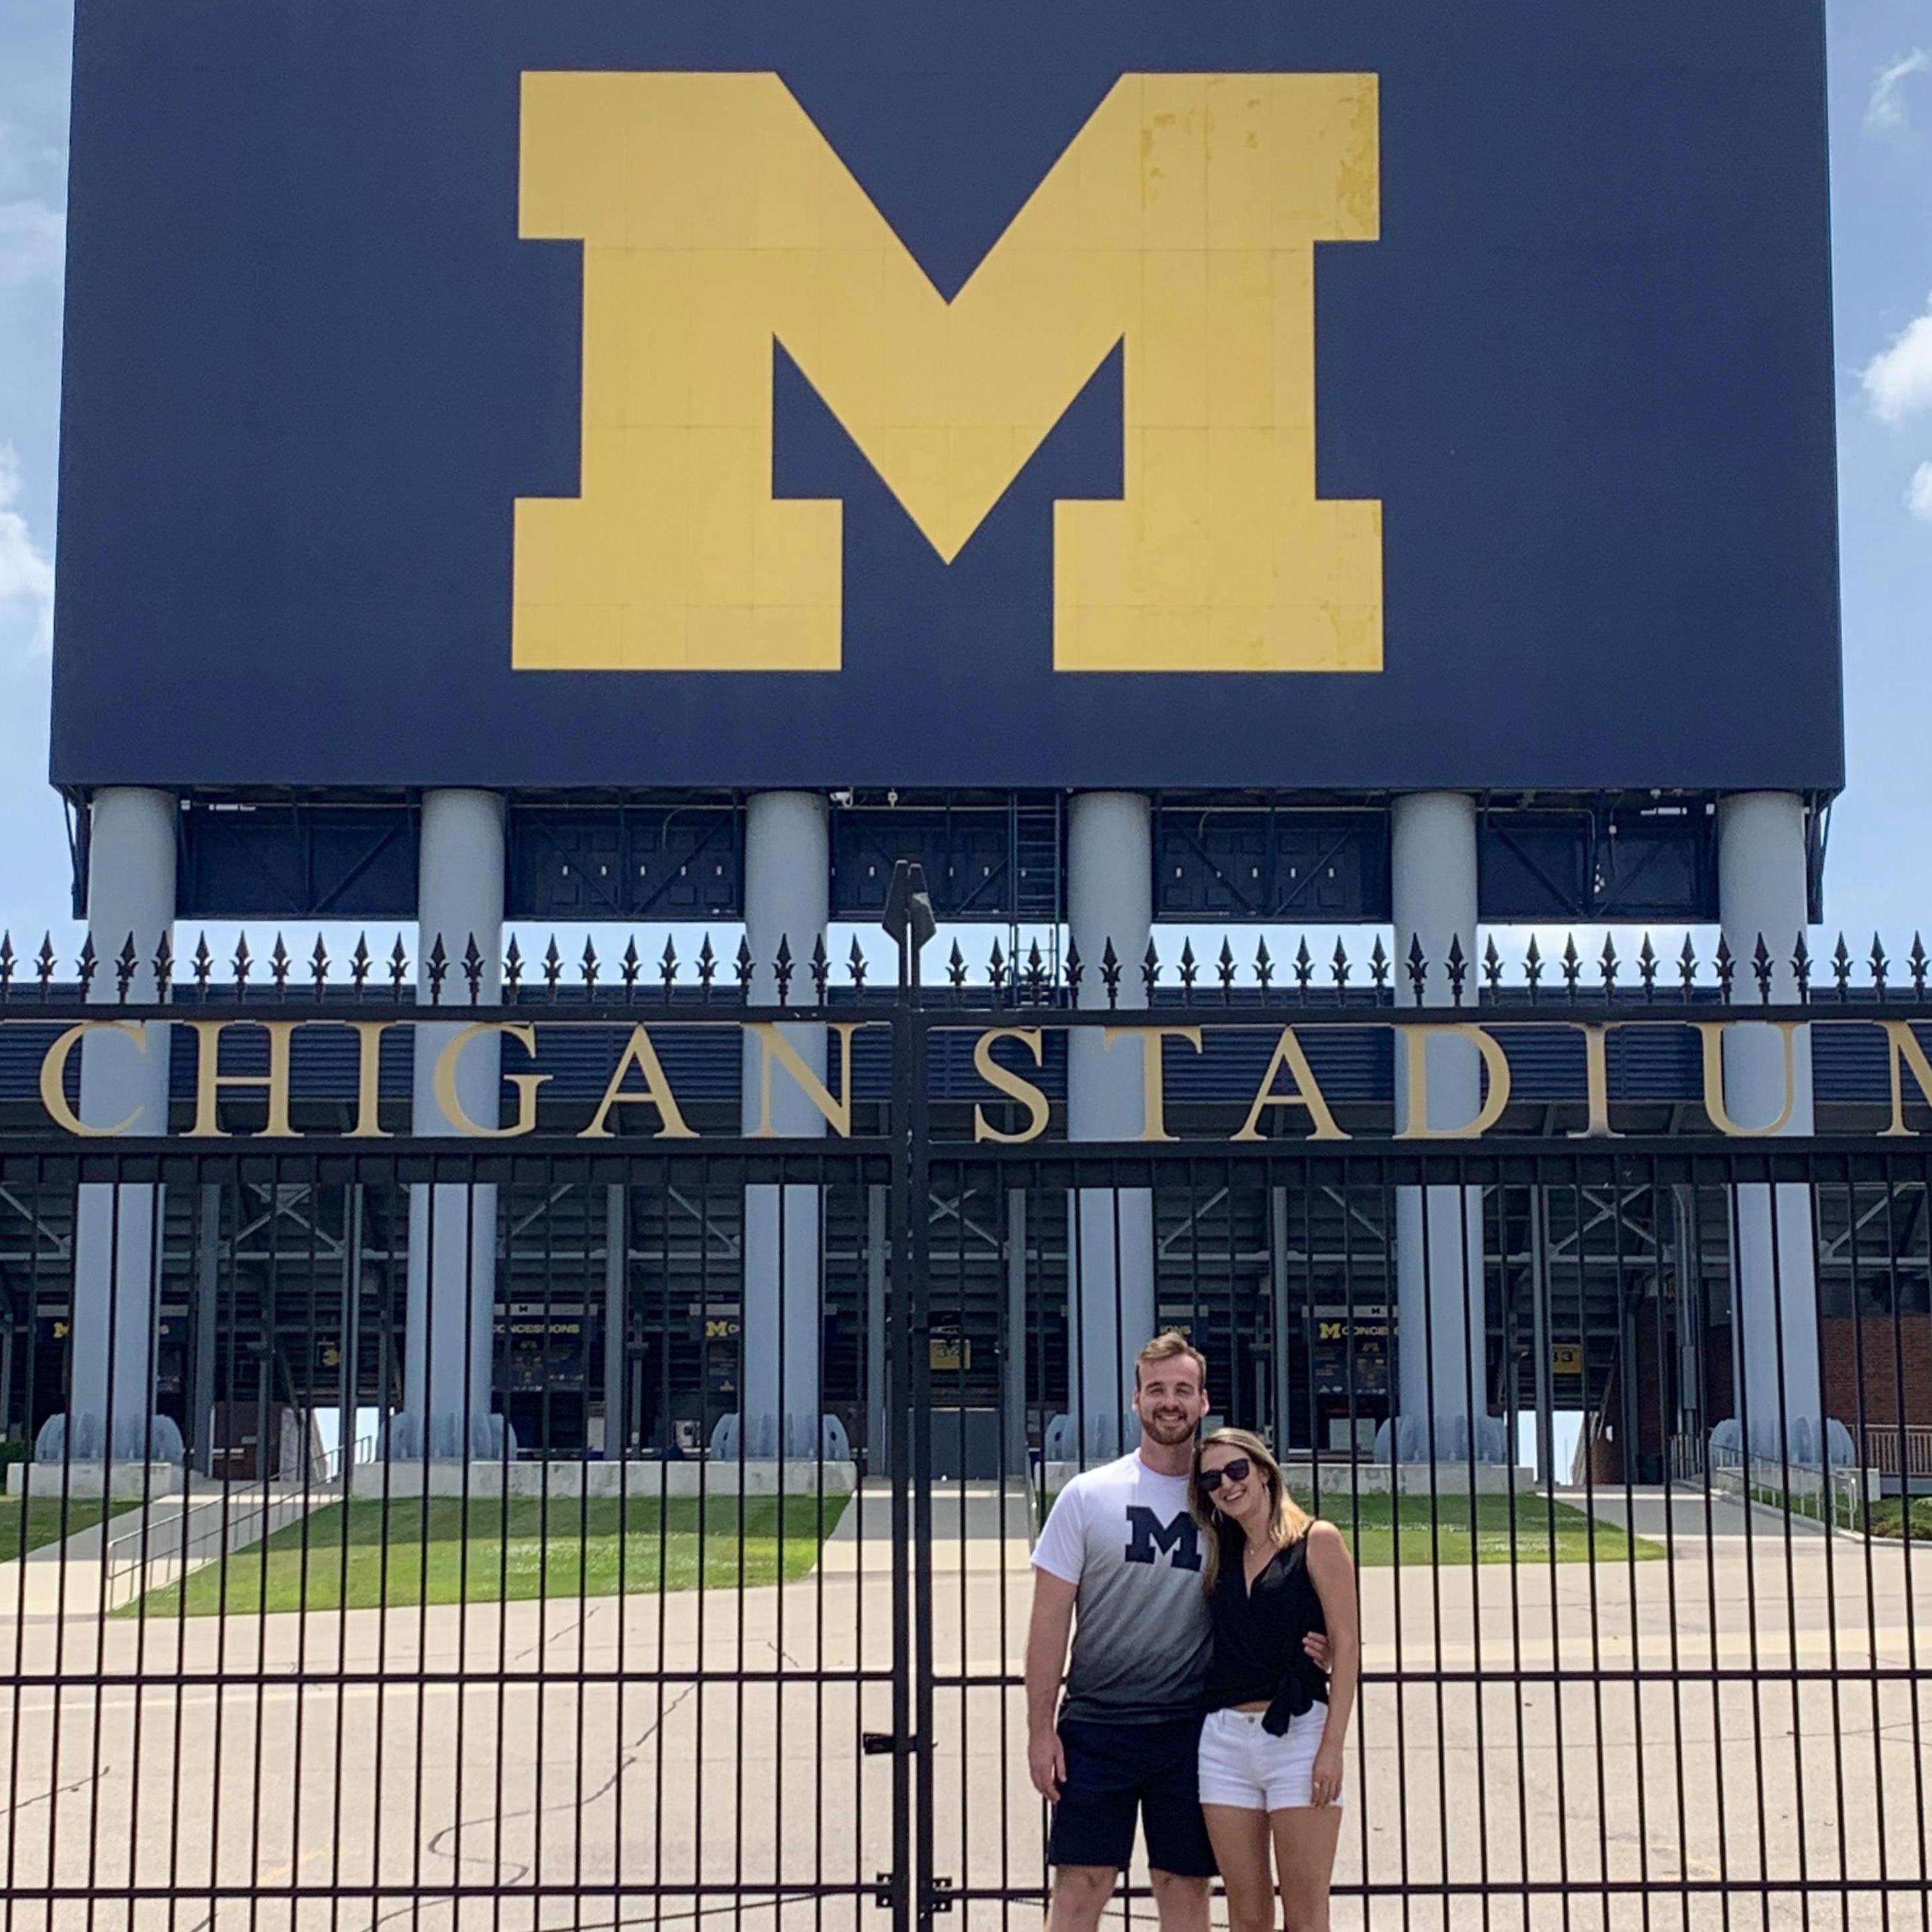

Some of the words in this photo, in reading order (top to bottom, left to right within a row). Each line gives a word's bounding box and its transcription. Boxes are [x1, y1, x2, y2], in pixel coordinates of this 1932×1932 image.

[512, 71, 1383, 672] M
[39, 1021, 867, 1138] CHIGAN
[705, 1321, 728, 1336] M
[1319, 1323, 1341, 1339] M
[1125, 1505, 1202, 1572] M
